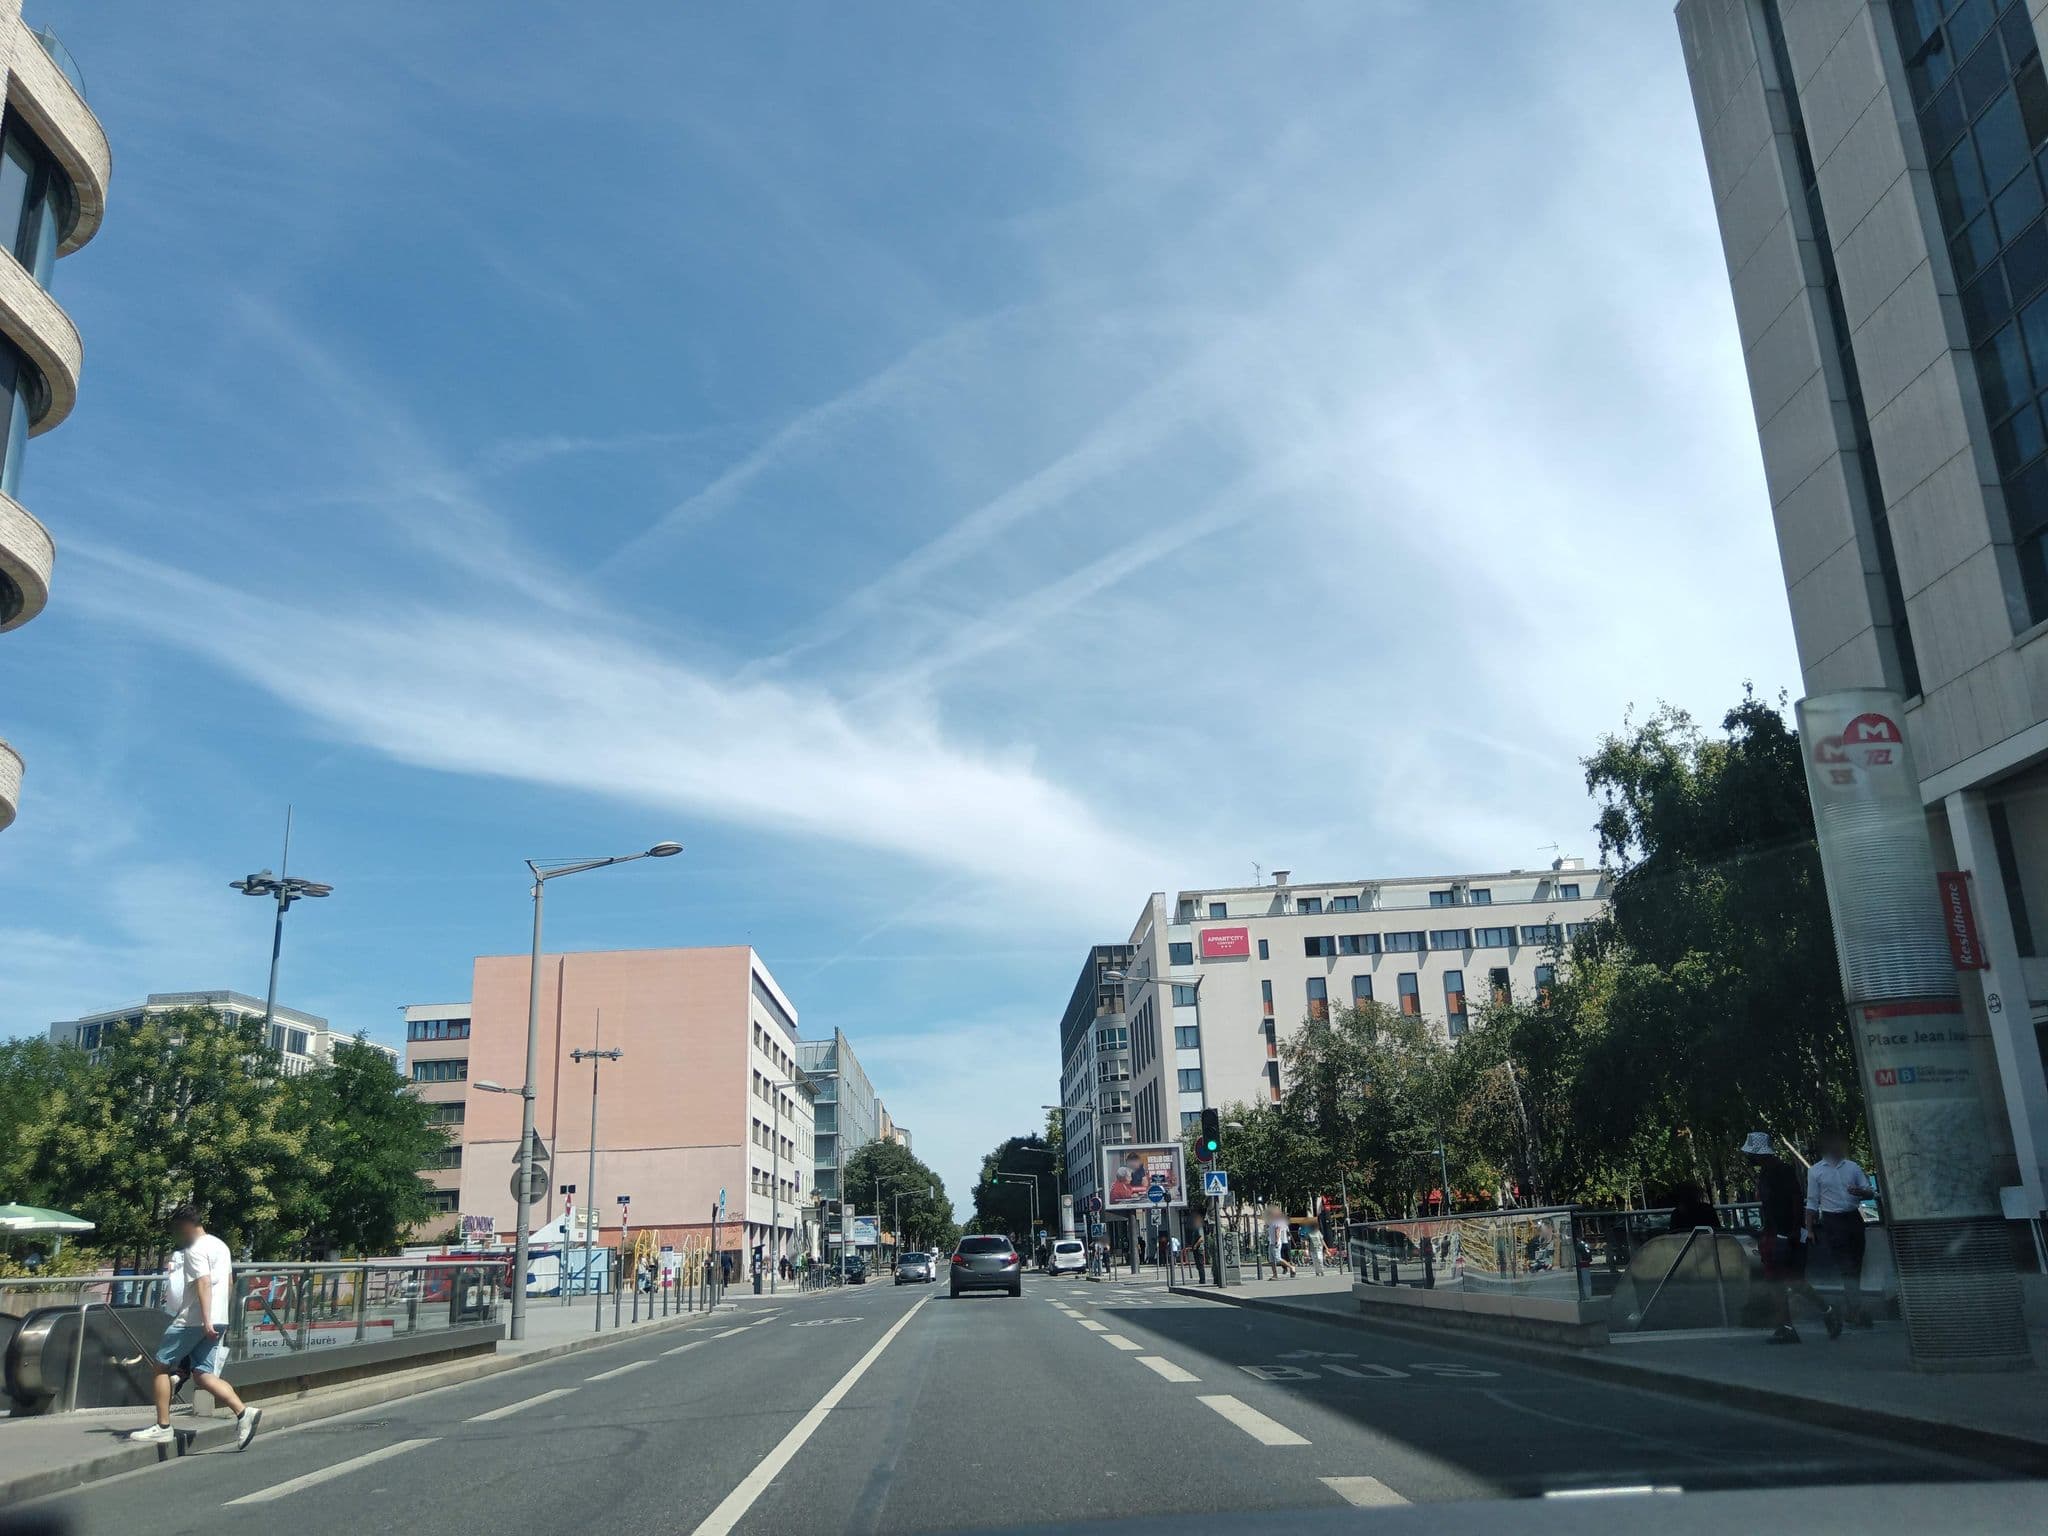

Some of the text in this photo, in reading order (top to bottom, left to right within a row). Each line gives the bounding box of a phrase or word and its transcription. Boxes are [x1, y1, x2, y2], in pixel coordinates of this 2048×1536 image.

[1857, 722, 1890, 740] M
[1948, 883, 1976, 964] Residhome
[1866, 1031, 1907, 1047] Place
[1914, 1028, 1945, 1043] Jean
[1878, 1071, 1895, 1086] M
[252, 1338, 278, 1348] Place
[306, 1335, 337, 1347] Jaurès
[1237, 1363, 1501, 1381] BUS
